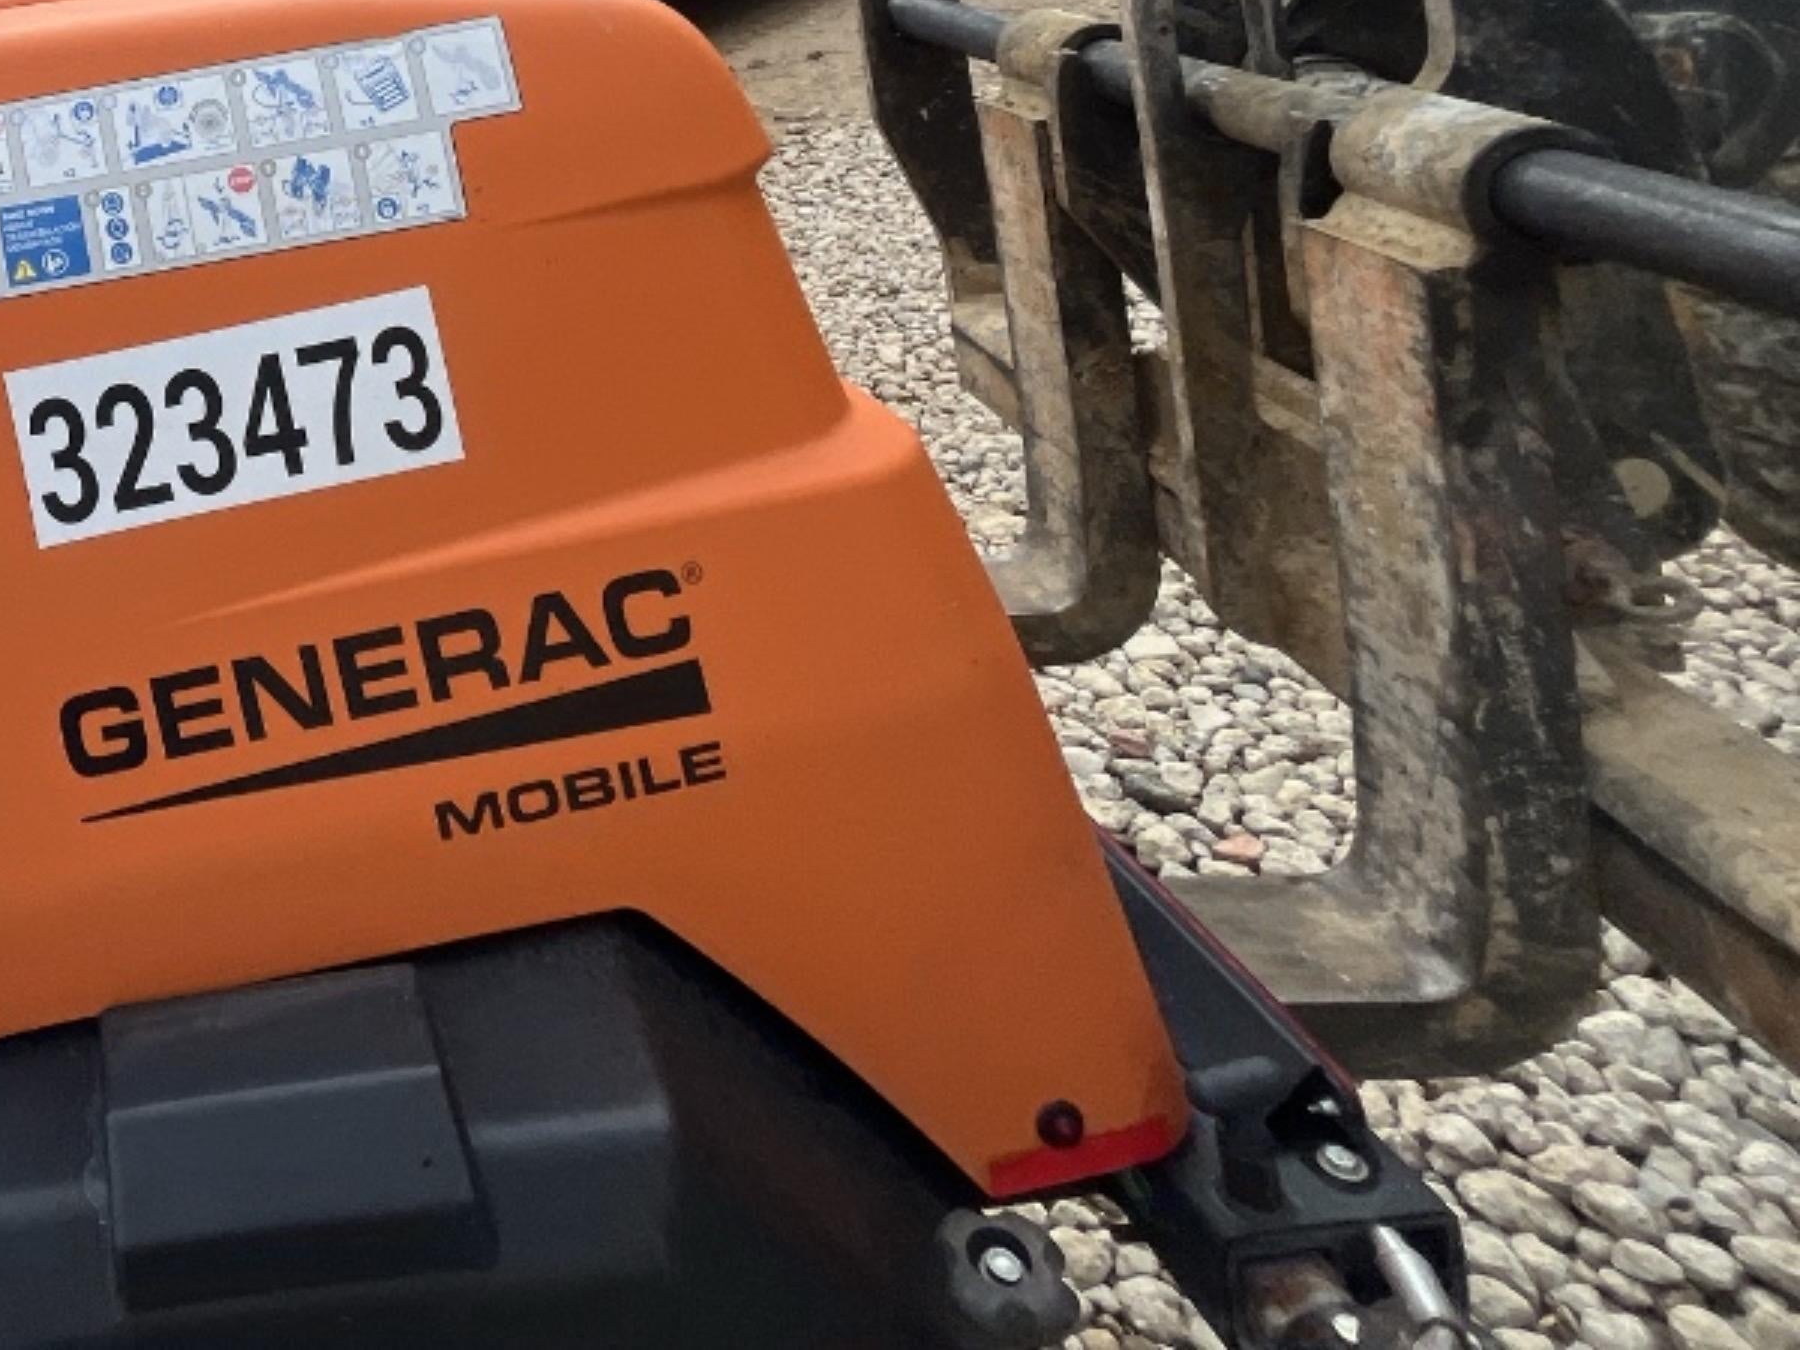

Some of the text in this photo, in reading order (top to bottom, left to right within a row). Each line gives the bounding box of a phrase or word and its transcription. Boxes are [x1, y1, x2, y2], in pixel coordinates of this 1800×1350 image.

[27, 325, 444, 525] 323473
[59, 567, 693, 780] GENERAC
[434, 741, 728, 842] MOBILE
